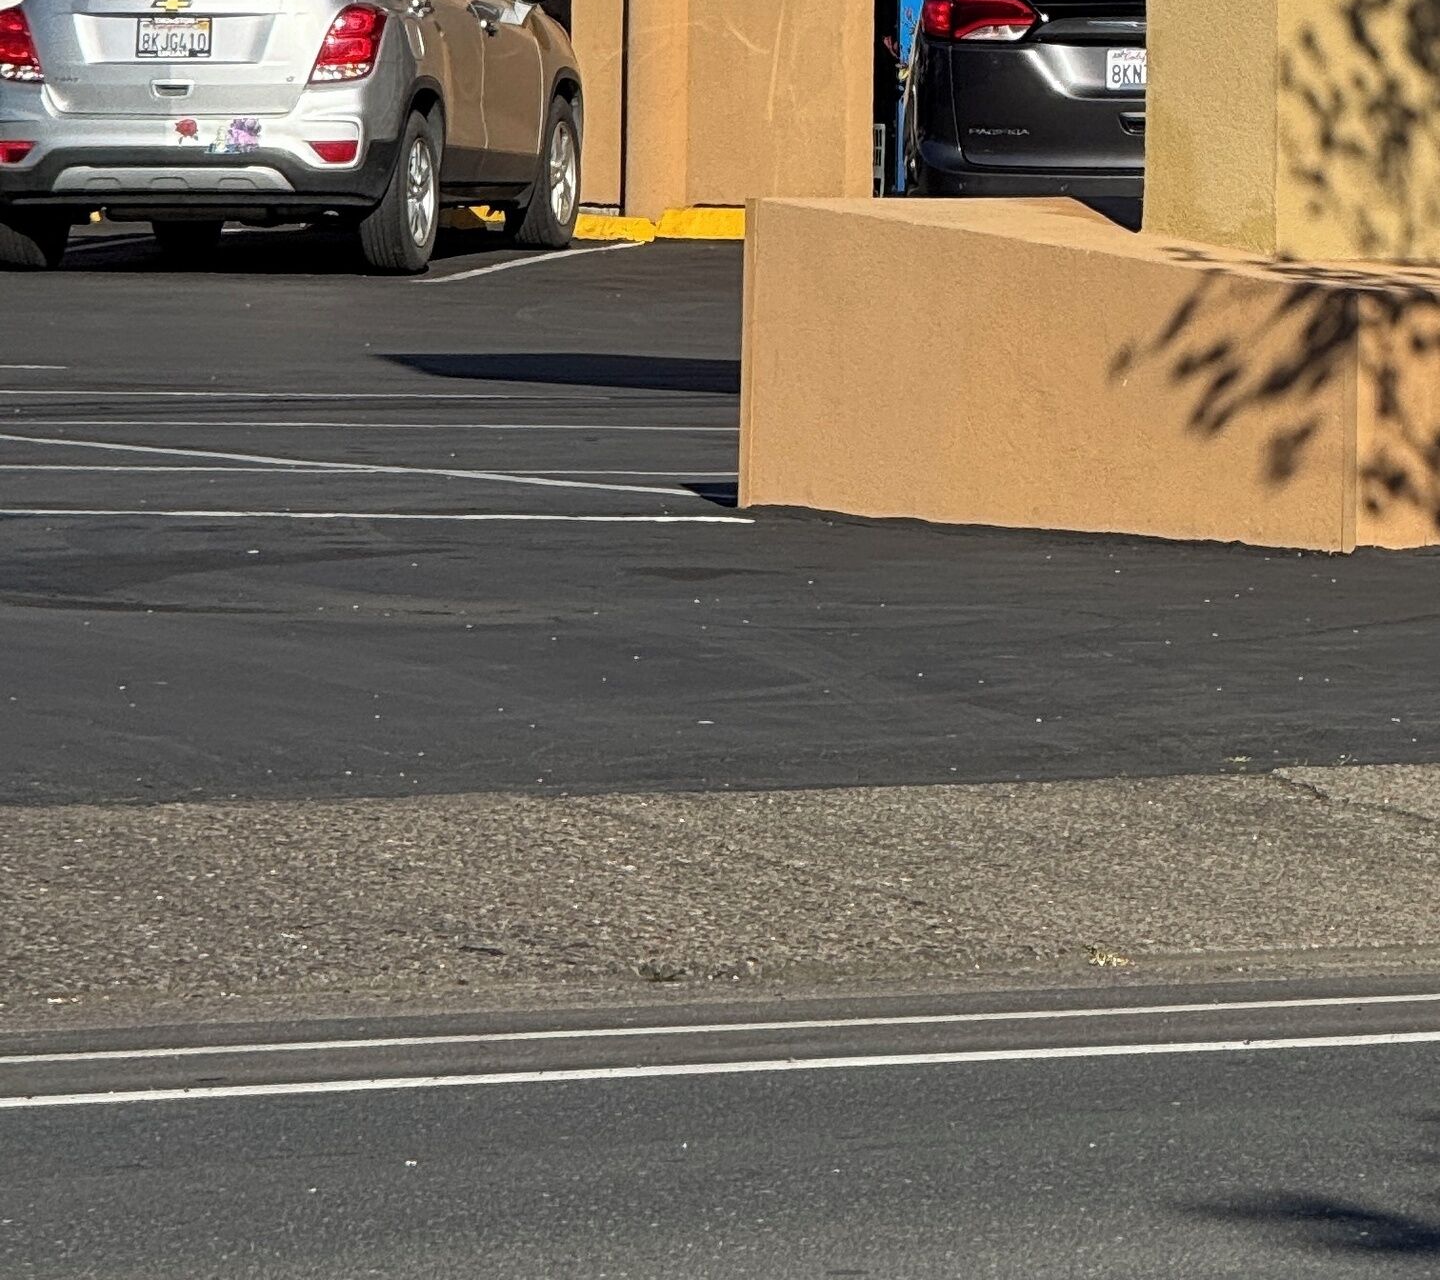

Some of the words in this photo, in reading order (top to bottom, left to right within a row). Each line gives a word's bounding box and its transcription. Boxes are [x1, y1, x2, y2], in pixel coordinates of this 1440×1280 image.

[142, 32, 207, 52] 8KJG410
[1111, 64, 1147, 84] 8KN
[968, 127, 1030, 136] PACICA
